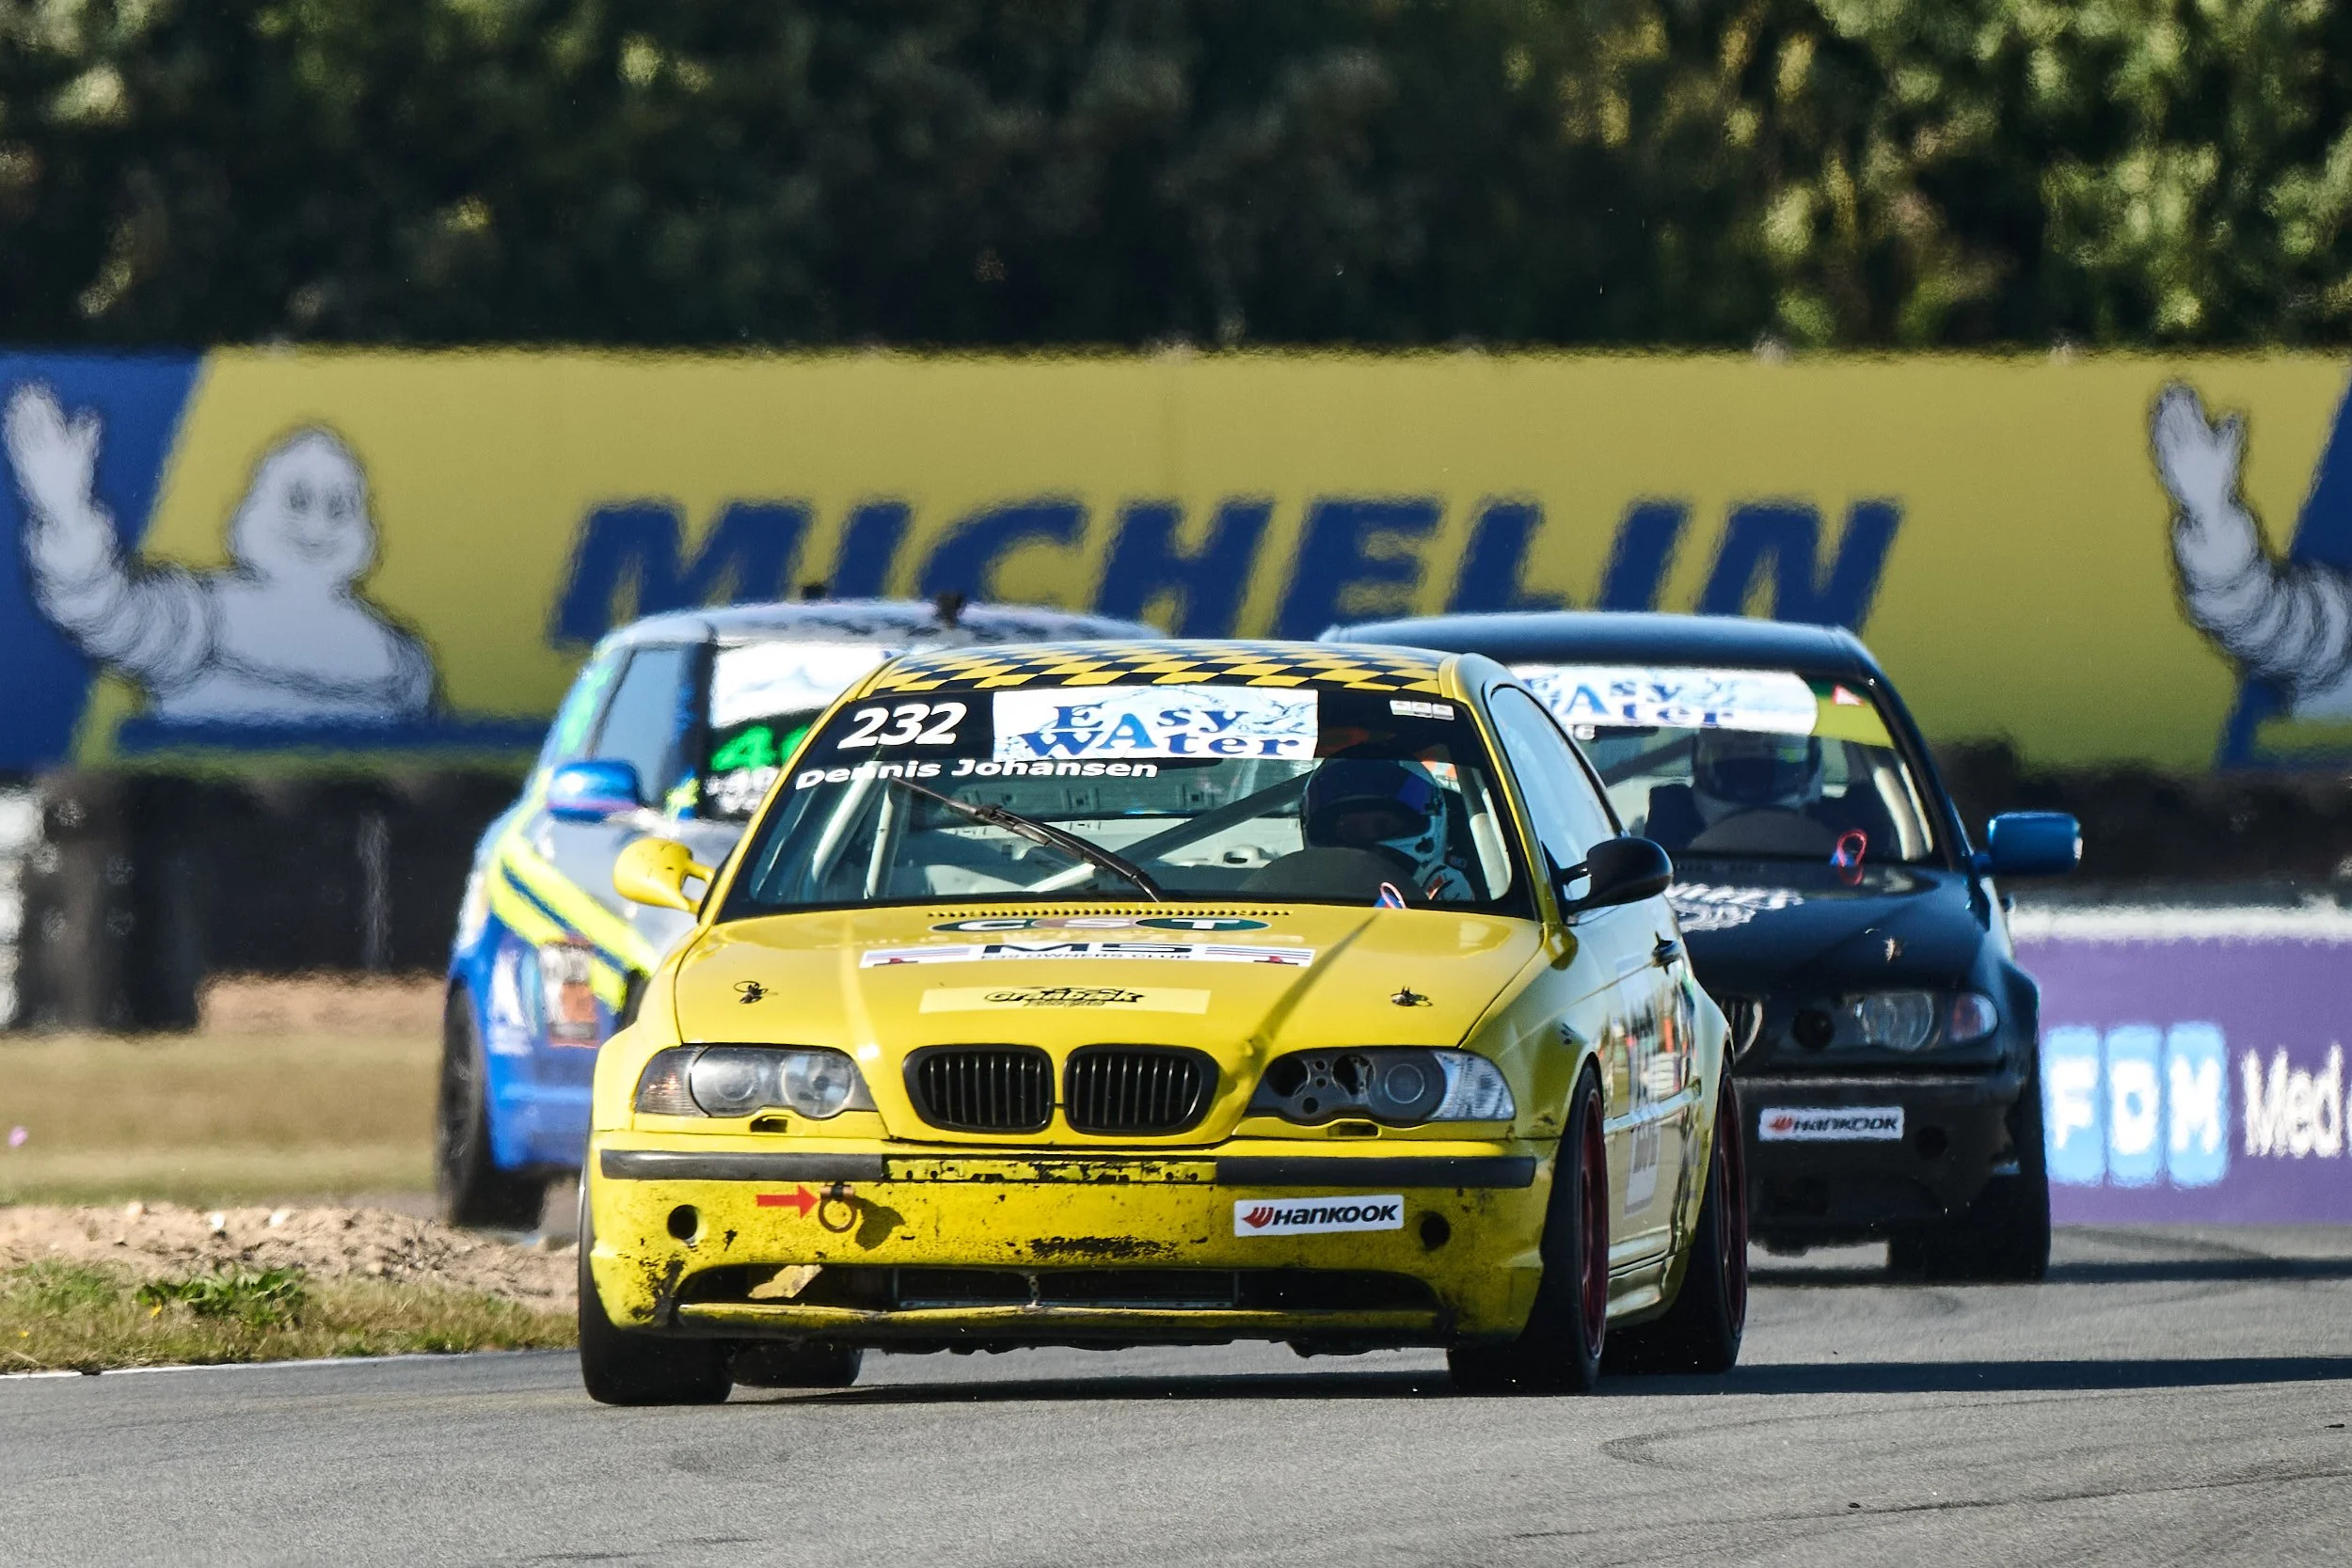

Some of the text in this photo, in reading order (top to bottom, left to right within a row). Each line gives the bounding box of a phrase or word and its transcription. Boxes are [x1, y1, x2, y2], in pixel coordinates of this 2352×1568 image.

[548, 499, 1901, 647] MICHELIN
[837, 702, 967, 750] 232
[796, 759, 942, 791] Dennis
[951, 759, 1158, 779] Johansen
[956, 917, 1242, 931] CST
[2241, 1042, 2352, 1159] Med
